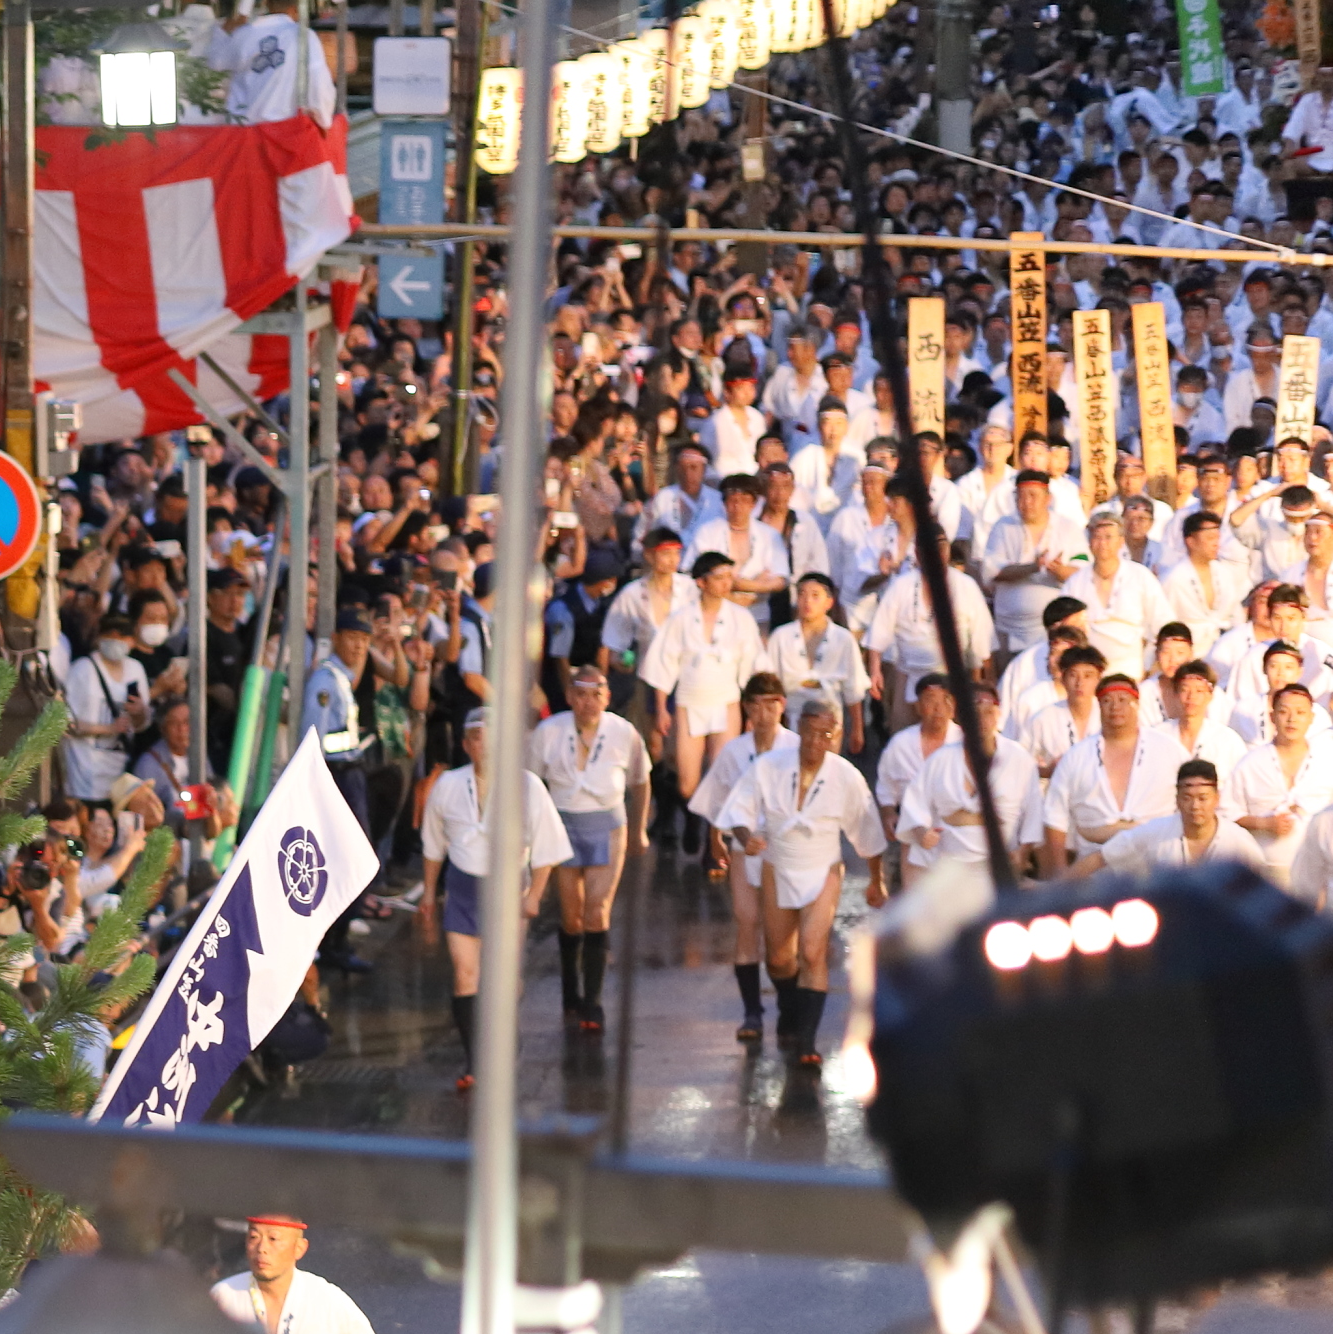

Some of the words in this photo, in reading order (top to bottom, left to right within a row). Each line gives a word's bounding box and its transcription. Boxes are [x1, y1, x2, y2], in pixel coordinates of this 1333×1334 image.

[1014, 251, 1042, 343] 五番山笠
[912, 332, 942, 423] 西流
